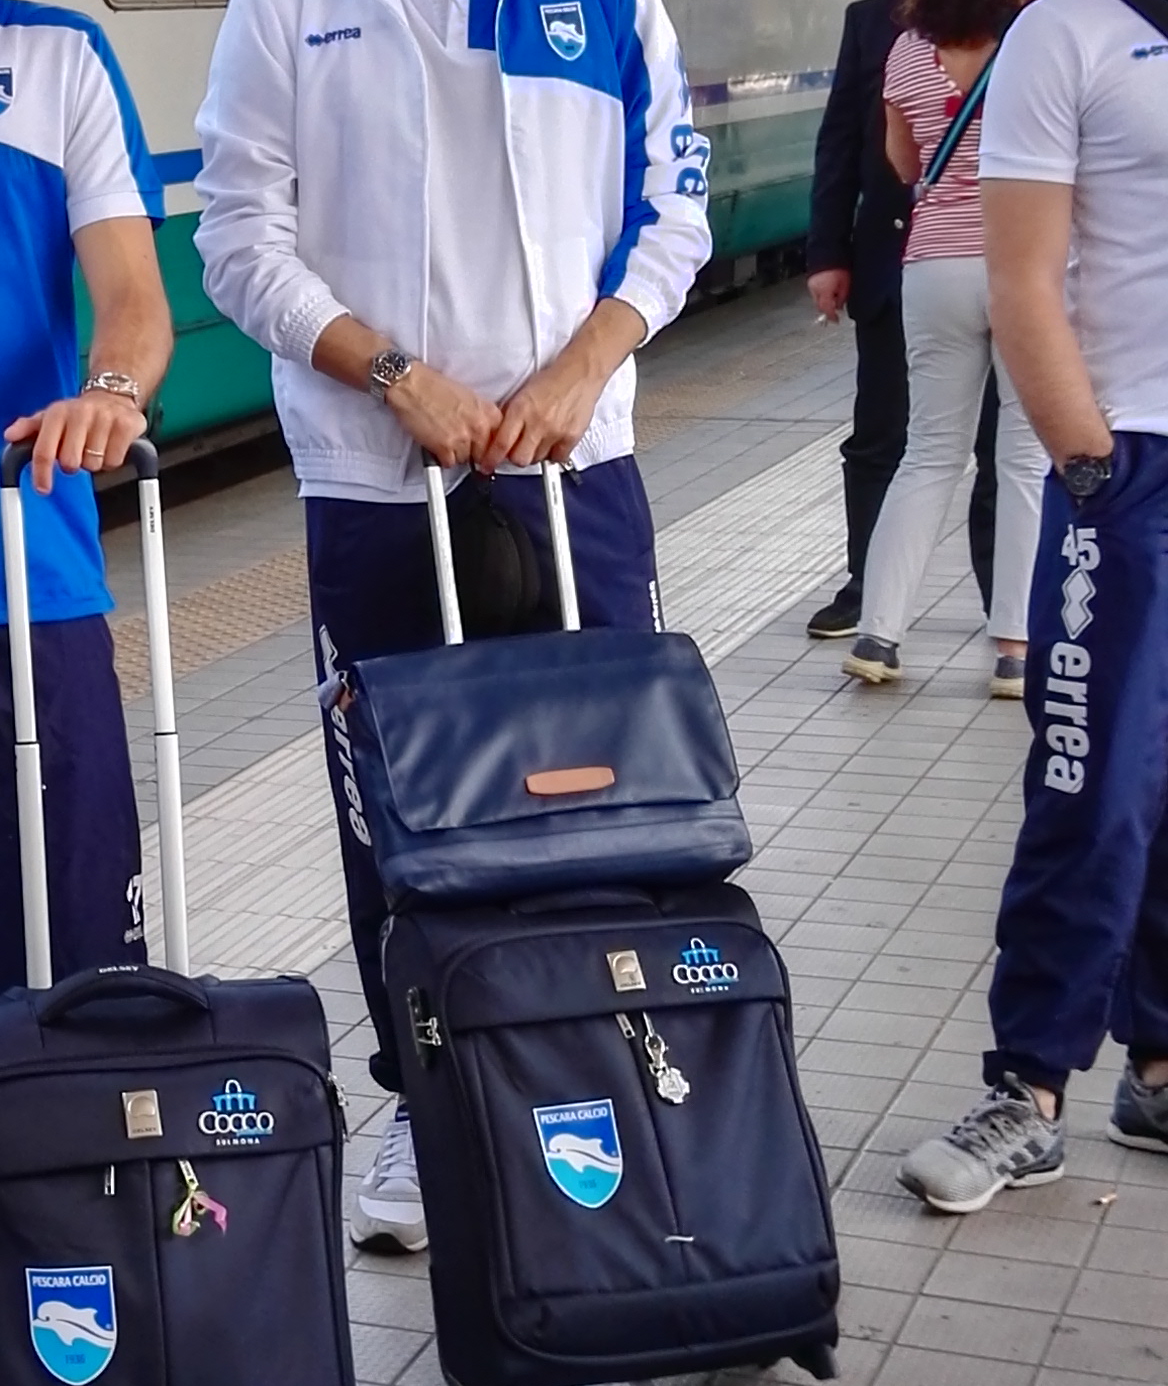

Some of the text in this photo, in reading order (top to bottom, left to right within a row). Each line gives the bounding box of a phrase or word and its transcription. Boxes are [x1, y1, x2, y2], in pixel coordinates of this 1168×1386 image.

[1043, 641, 1092, 795] errea
[32, 1274, 107, 1287] PESCARA CALCIO
